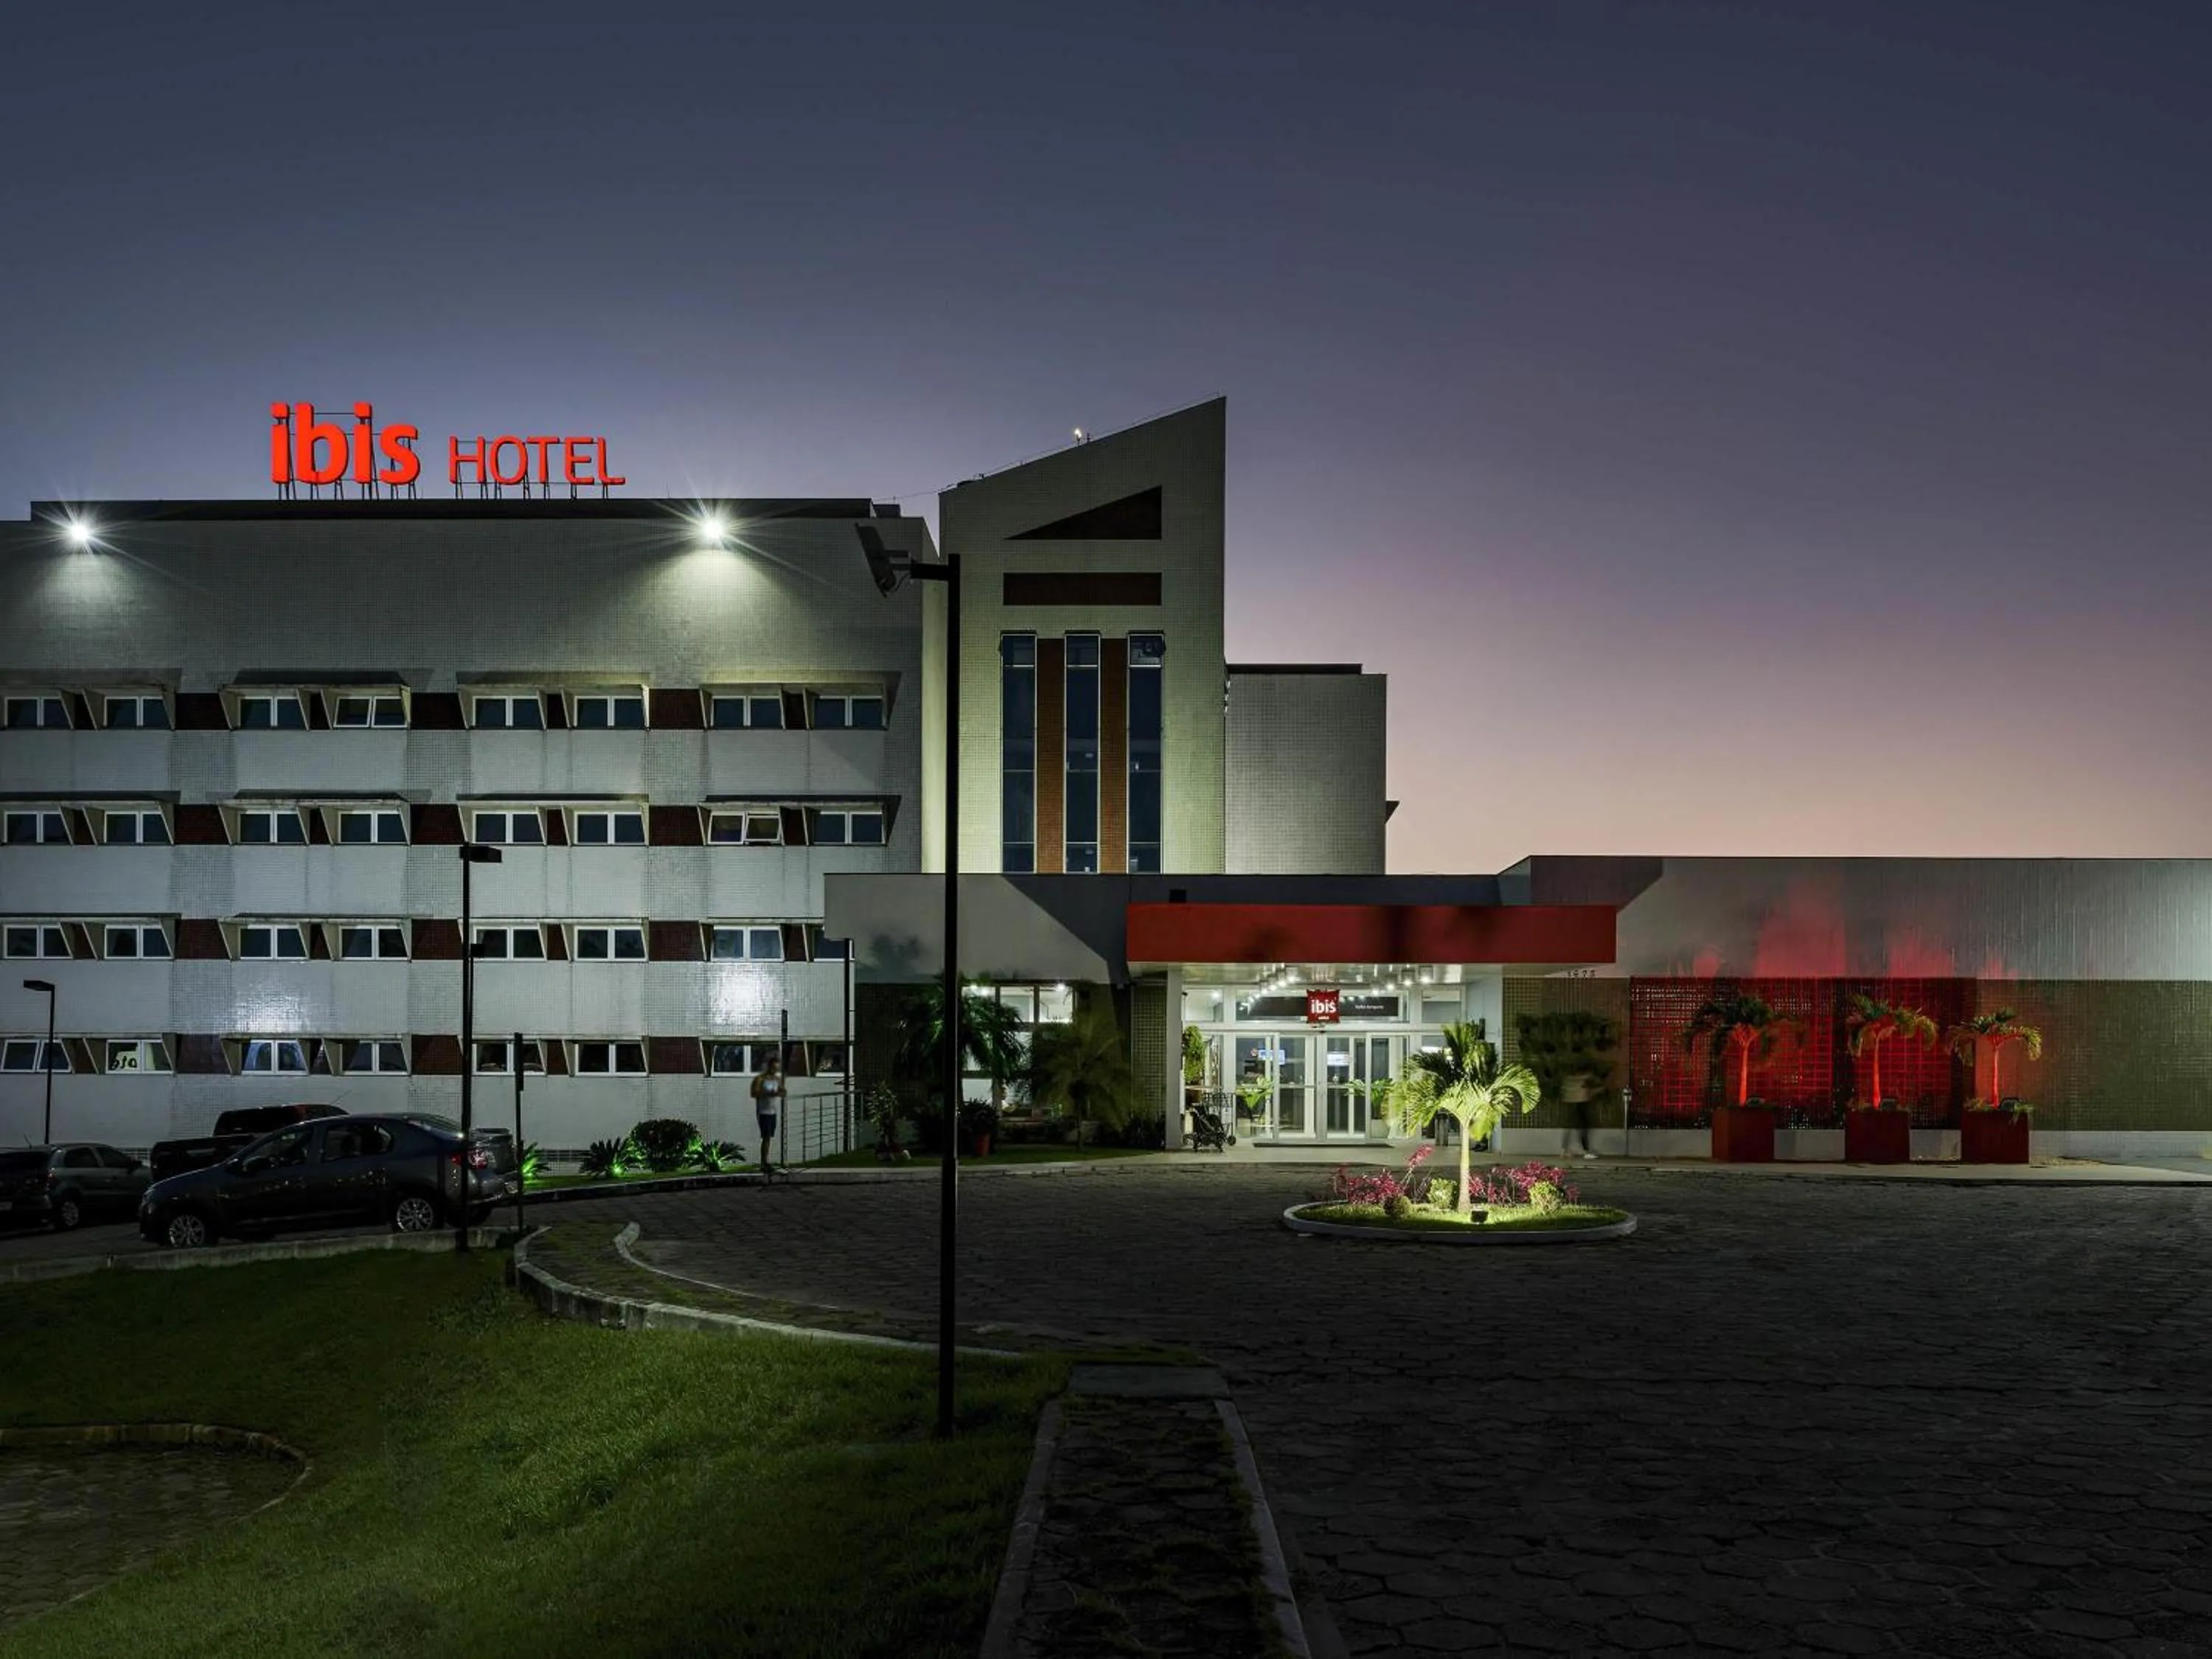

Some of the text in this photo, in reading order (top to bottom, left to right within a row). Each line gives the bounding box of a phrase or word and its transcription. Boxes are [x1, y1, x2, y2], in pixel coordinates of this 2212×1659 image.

[271, 402, 626, 485] ibis HOTEL
[1311, 999, 1337, 1014] ibis
